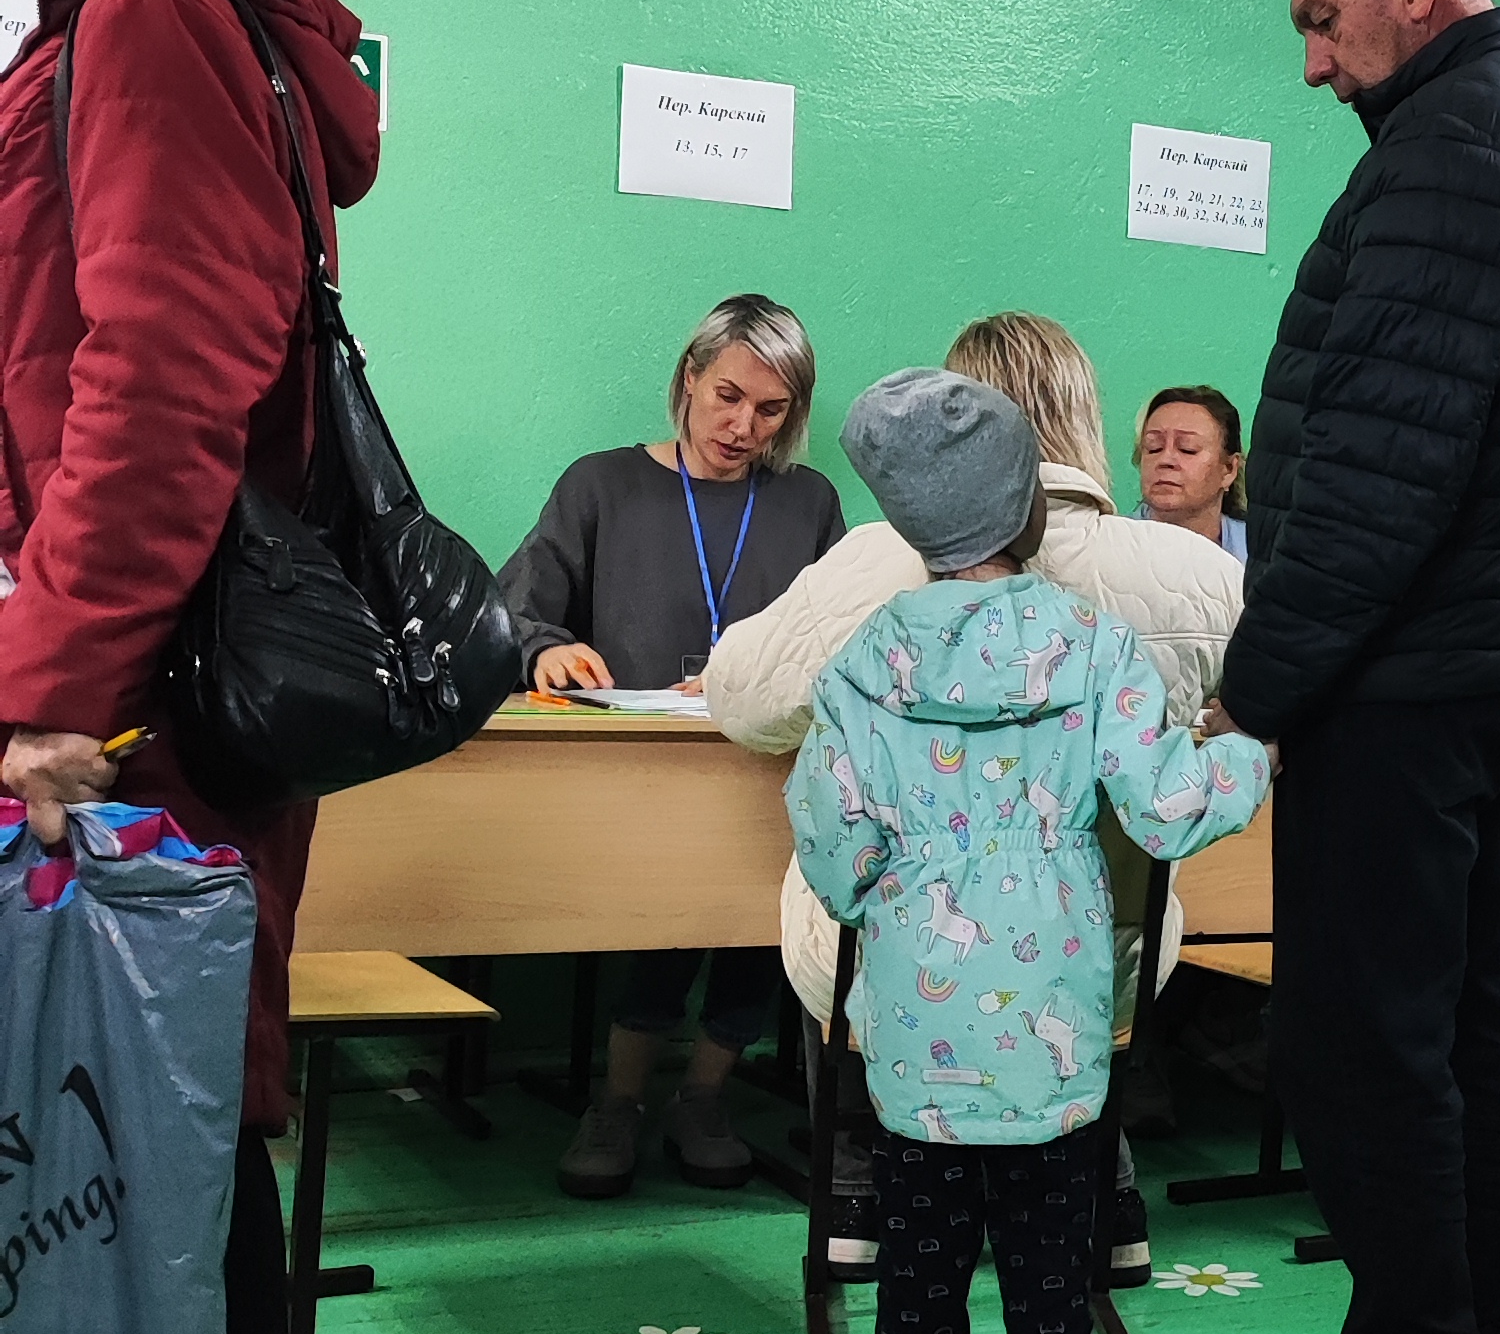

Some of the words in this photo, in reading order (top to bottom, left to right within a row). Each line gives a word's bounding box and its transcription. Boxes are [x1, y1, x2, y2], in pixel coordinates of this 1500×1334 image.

[0, 15, 26, 36] ер
[658, 95, 692, 117] Пер.
[697, 101, 766, 124] Карский
[675, 139, 694, 155] 13,
[704, 142, 723, 158] 15,
[732, 146, 748, 160] 17
[1159, 147, 1189, 166] Пер.
[1193, 152, 1248, 173] Карский
[1187, 190, 1204, 205] 20,
[1208, 193, 1225, 207] 21,
[1229, 196, 1245, 210] 22,
[1250, 216, 1264, 229] 38
